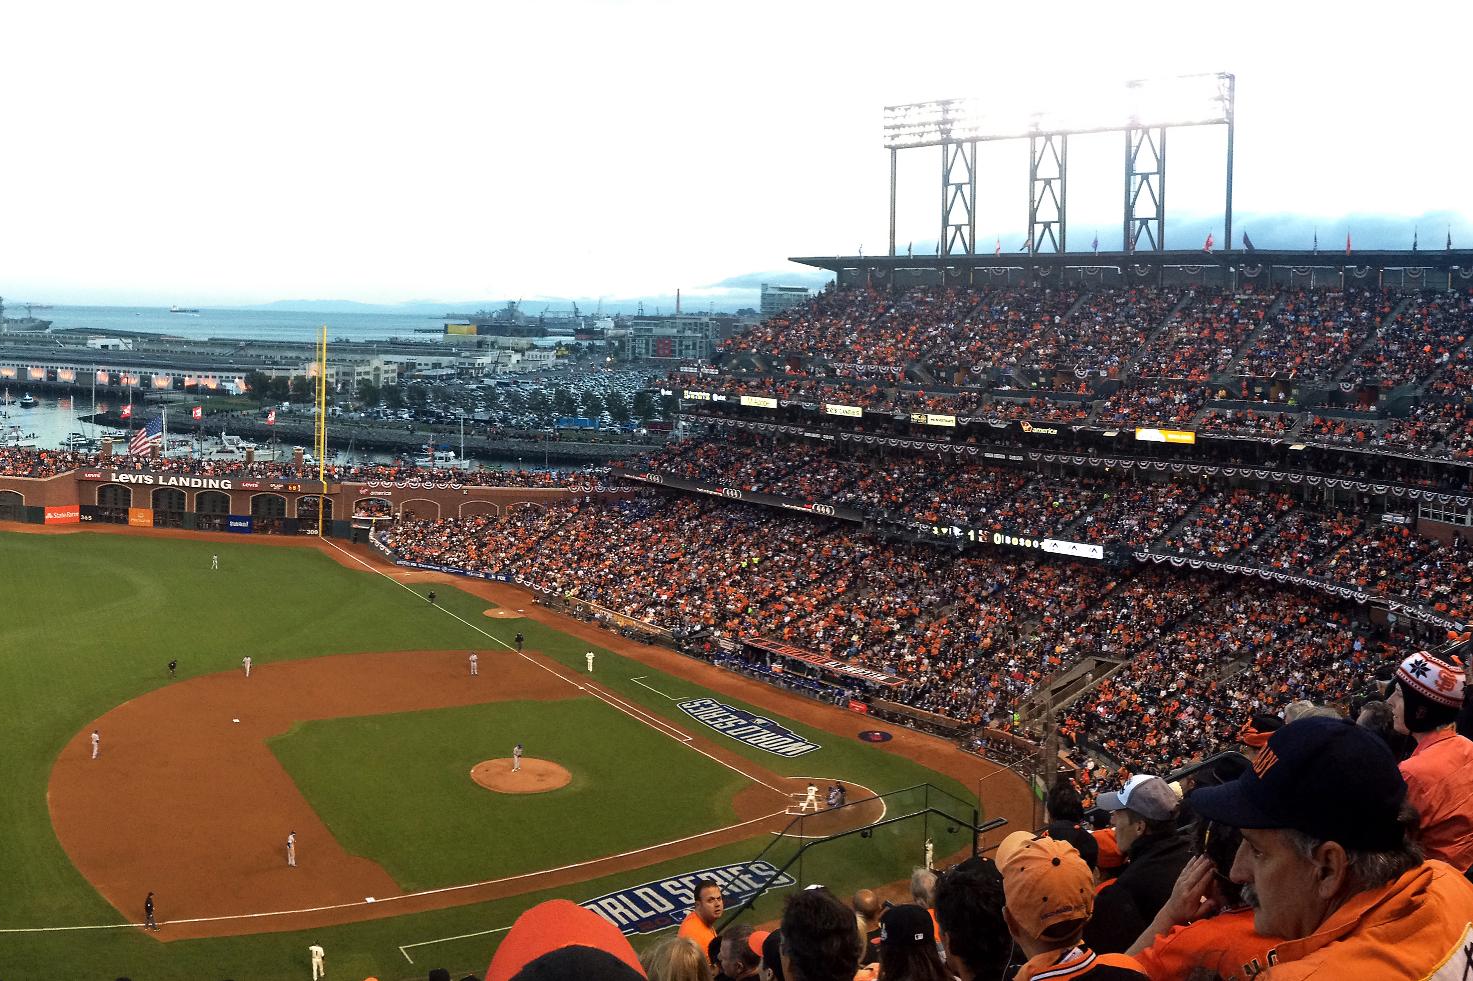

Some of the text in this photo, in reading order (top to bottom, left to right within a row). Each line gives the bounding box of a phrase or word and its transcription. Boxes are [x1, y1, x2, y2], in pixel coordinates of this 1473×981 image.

[1032, 427, 1058, 435] america
[158, 475, 232, 489] LANDING
[53, 511, 67, 519] State
[682, 698, 817, 757] WORLD SERIES
[583, 886, 676, 928] ORLD
